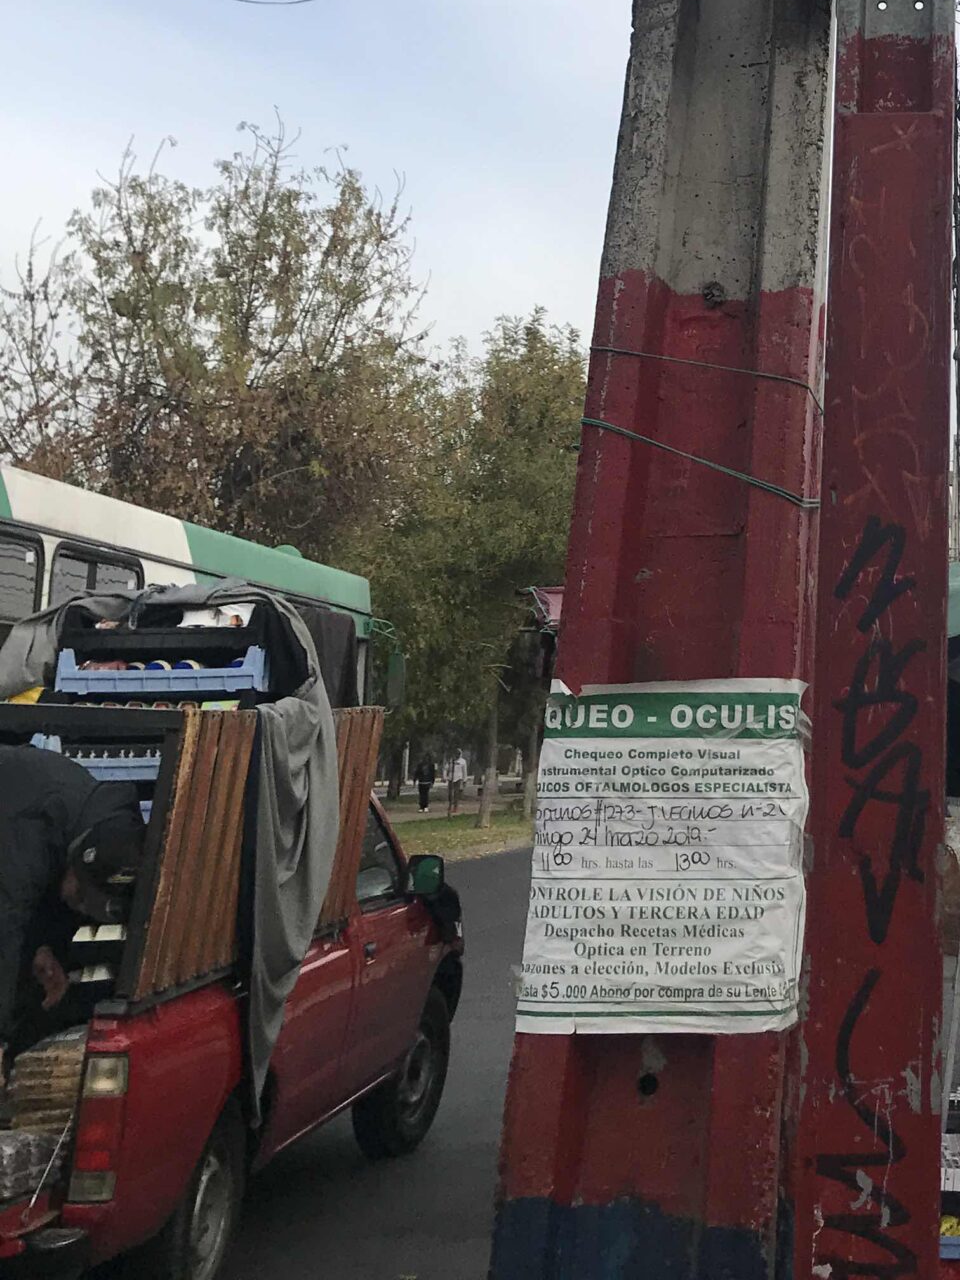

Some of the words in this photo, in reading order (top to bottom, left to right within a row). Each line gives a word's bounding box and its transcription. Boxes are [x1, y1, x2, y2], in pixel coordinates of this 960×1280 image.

[670, 704, 796, 730] OCULIS
[564, 748, 623, 762] Chequeo
[628, 748, 693, 762] Completo
[697, 748, 741, 760] Visual
[621, 765, 666, 778] Optico
[670, 765, 775, 779] Computarizado
[574, 781, 690, 793] OFTALMOLOGOS
[605, 856, 634, 869] hasta
[638, 856, 654, 869] las
[716, 856, 737, 869] hrs.
[608, 887, 632, 901] LA
[636, 883, 698, 901] VISIÓN
[703, 887, 726, 901] DE
[732, 883, 785, 901] NIÑOS
[611, 905, 622, 920] Y
[626, 905, 711, 920] TERCERA
[716, 905, 765, 920] EDAD
[543, 923, 615, 941] Despacho
[620, 923, 677, 938] Recetas
[682, 923, 745, 938] Médicas
[573, 942, 625, 960] Optica
[629, 945, 647, 956] en
[652, 942, 712, 956] Terreno
[570, 965, 579, 975] a
[584, 960, 649, 977] elección,
[654, 961, 717, 976] Modelos
[634, 986, 655, 1001] por
[657, 985, 704, 1002] compra
[708, 984, 723, 999] de
[726, 986, 741, 999] su
[745, 984, 777, 999] Lente
